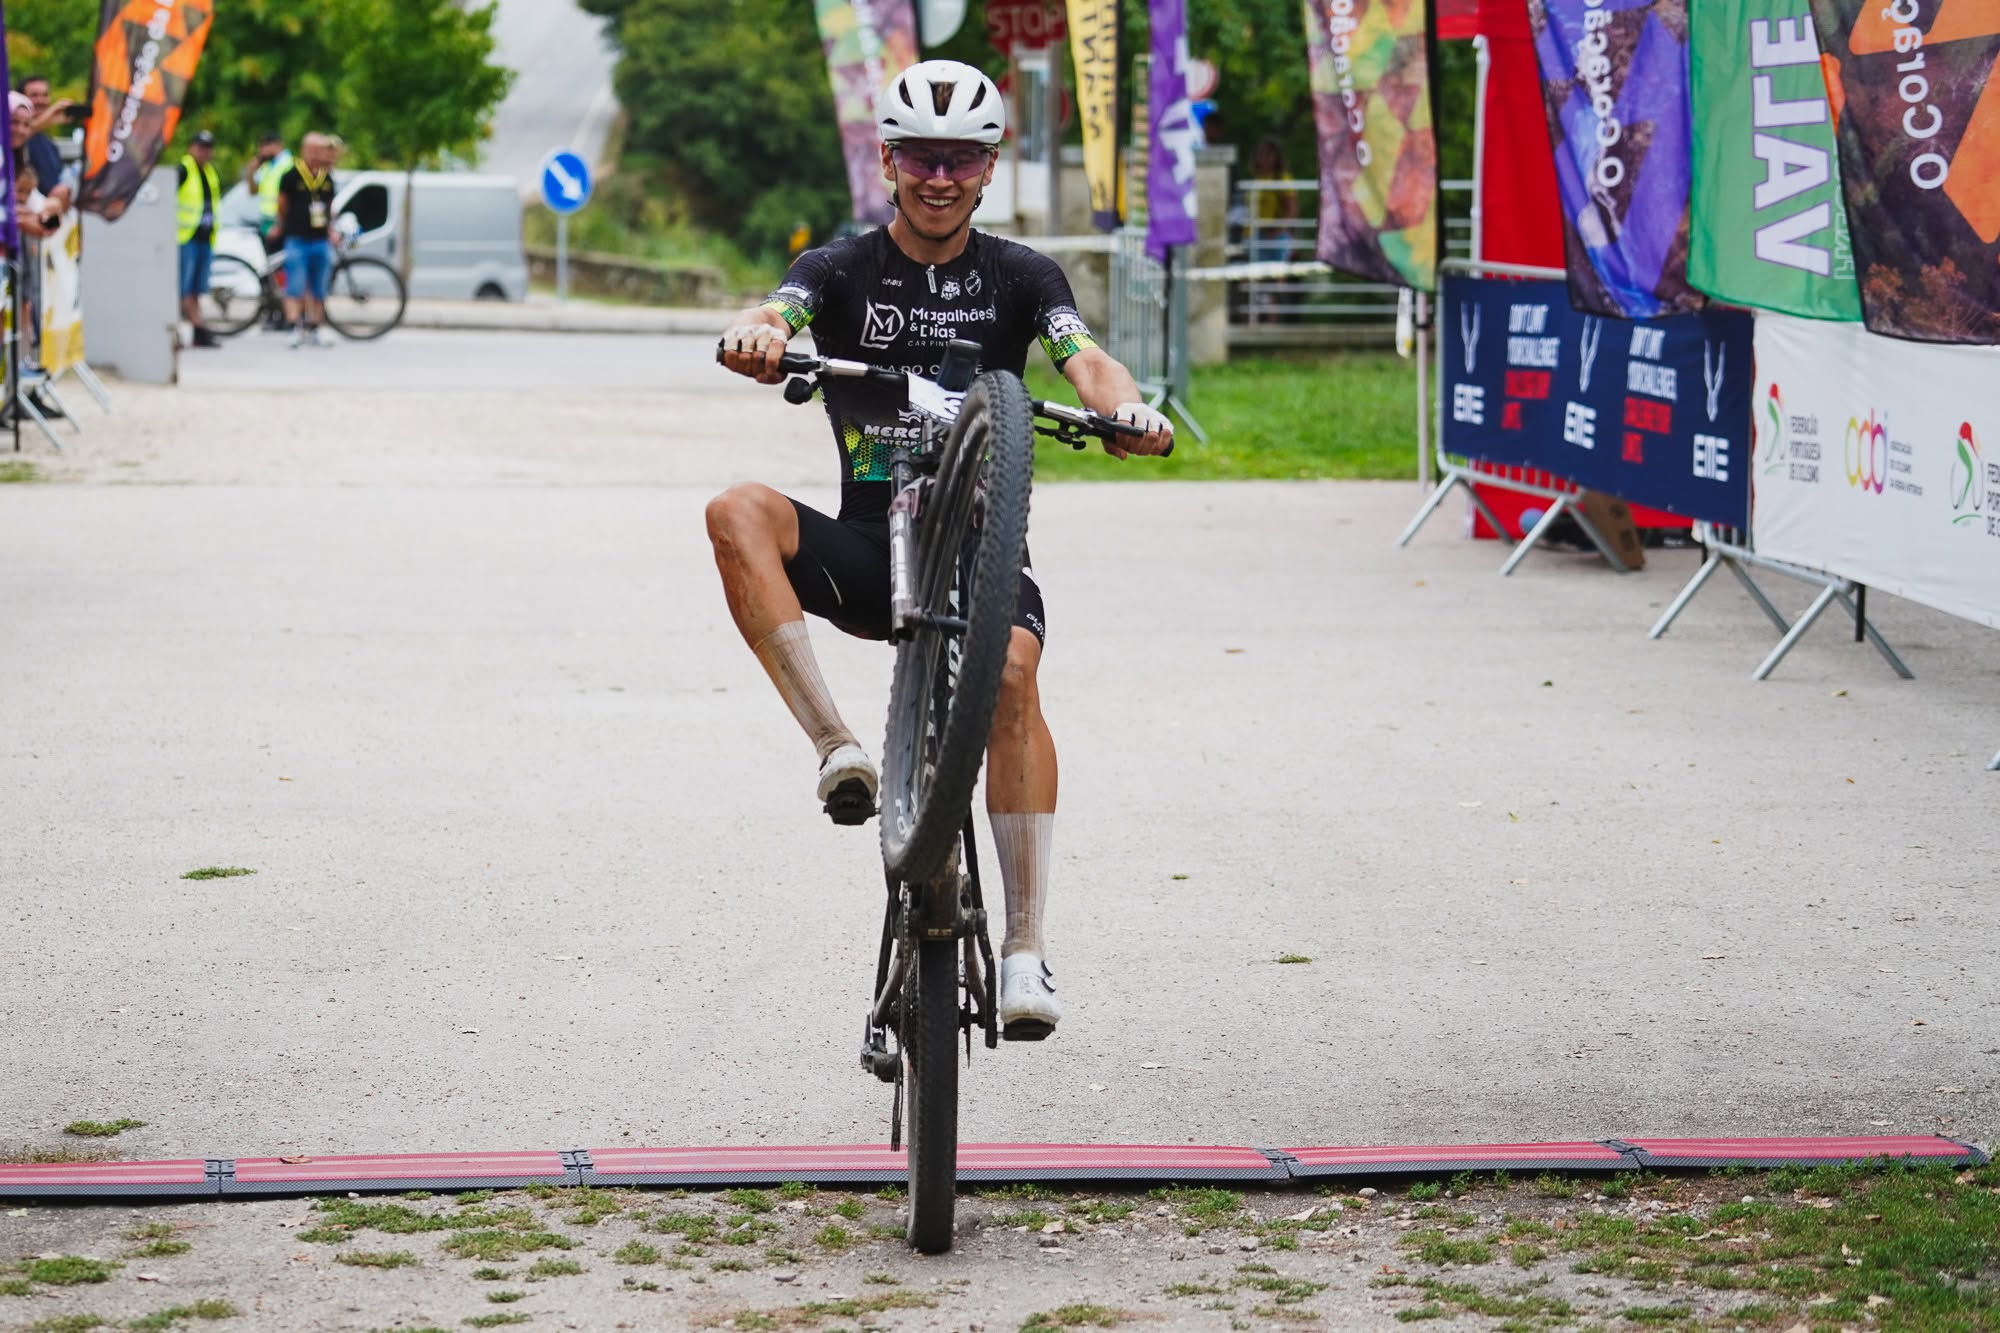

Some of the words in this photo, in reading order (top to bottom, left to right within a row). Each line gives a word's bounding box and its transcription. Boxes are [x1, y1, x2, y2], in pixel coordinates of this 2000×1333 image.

[987, 5, 1064, 37] STOP
[910, 306, 994, 325] Magalhães
[920, 324, 957, 338] Dias
[863, 424, 921, 439] MERC
[874, 438, 920, 447] ENTERP
